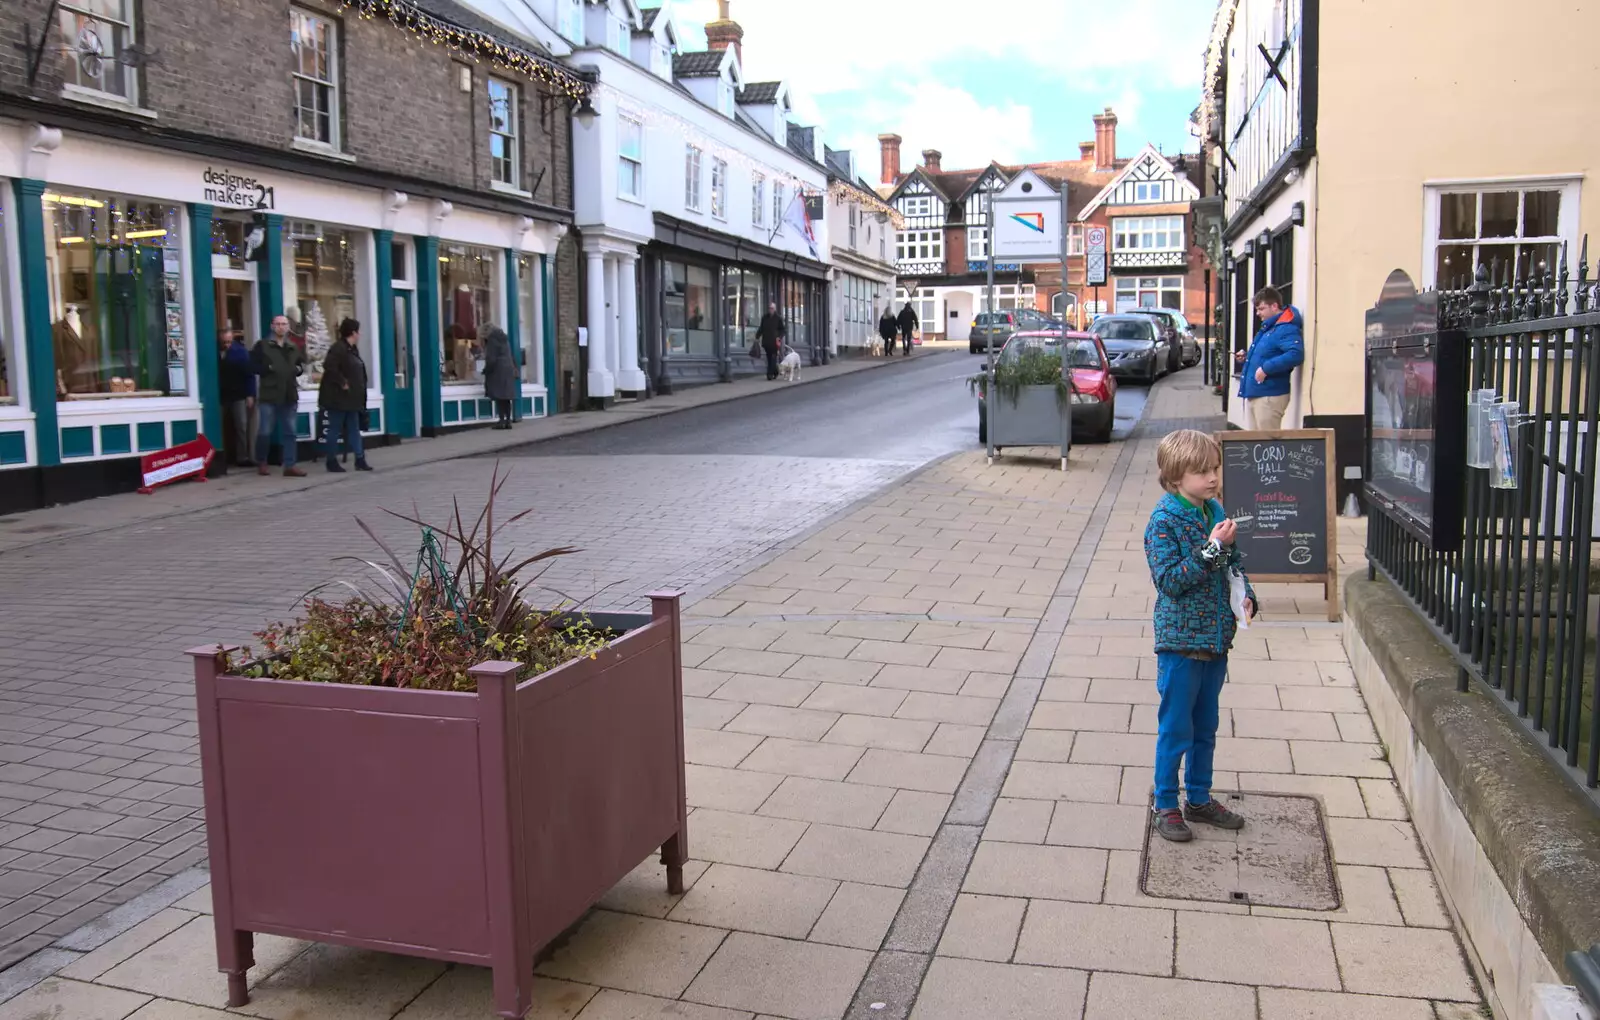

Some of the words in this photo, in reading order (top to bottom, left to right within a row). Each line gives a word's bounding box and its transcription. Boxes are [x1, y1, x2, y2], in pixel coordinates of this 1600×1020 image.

[203, 166, 257, 191] designer
[204, 187, 255, 207] makers
[256, 184, 274, 209] 21
[1253, 443, 1286, 463] CORN
[1300, 443, 1314, 455] WE
[1257, 461, 1286, 475] HALL
